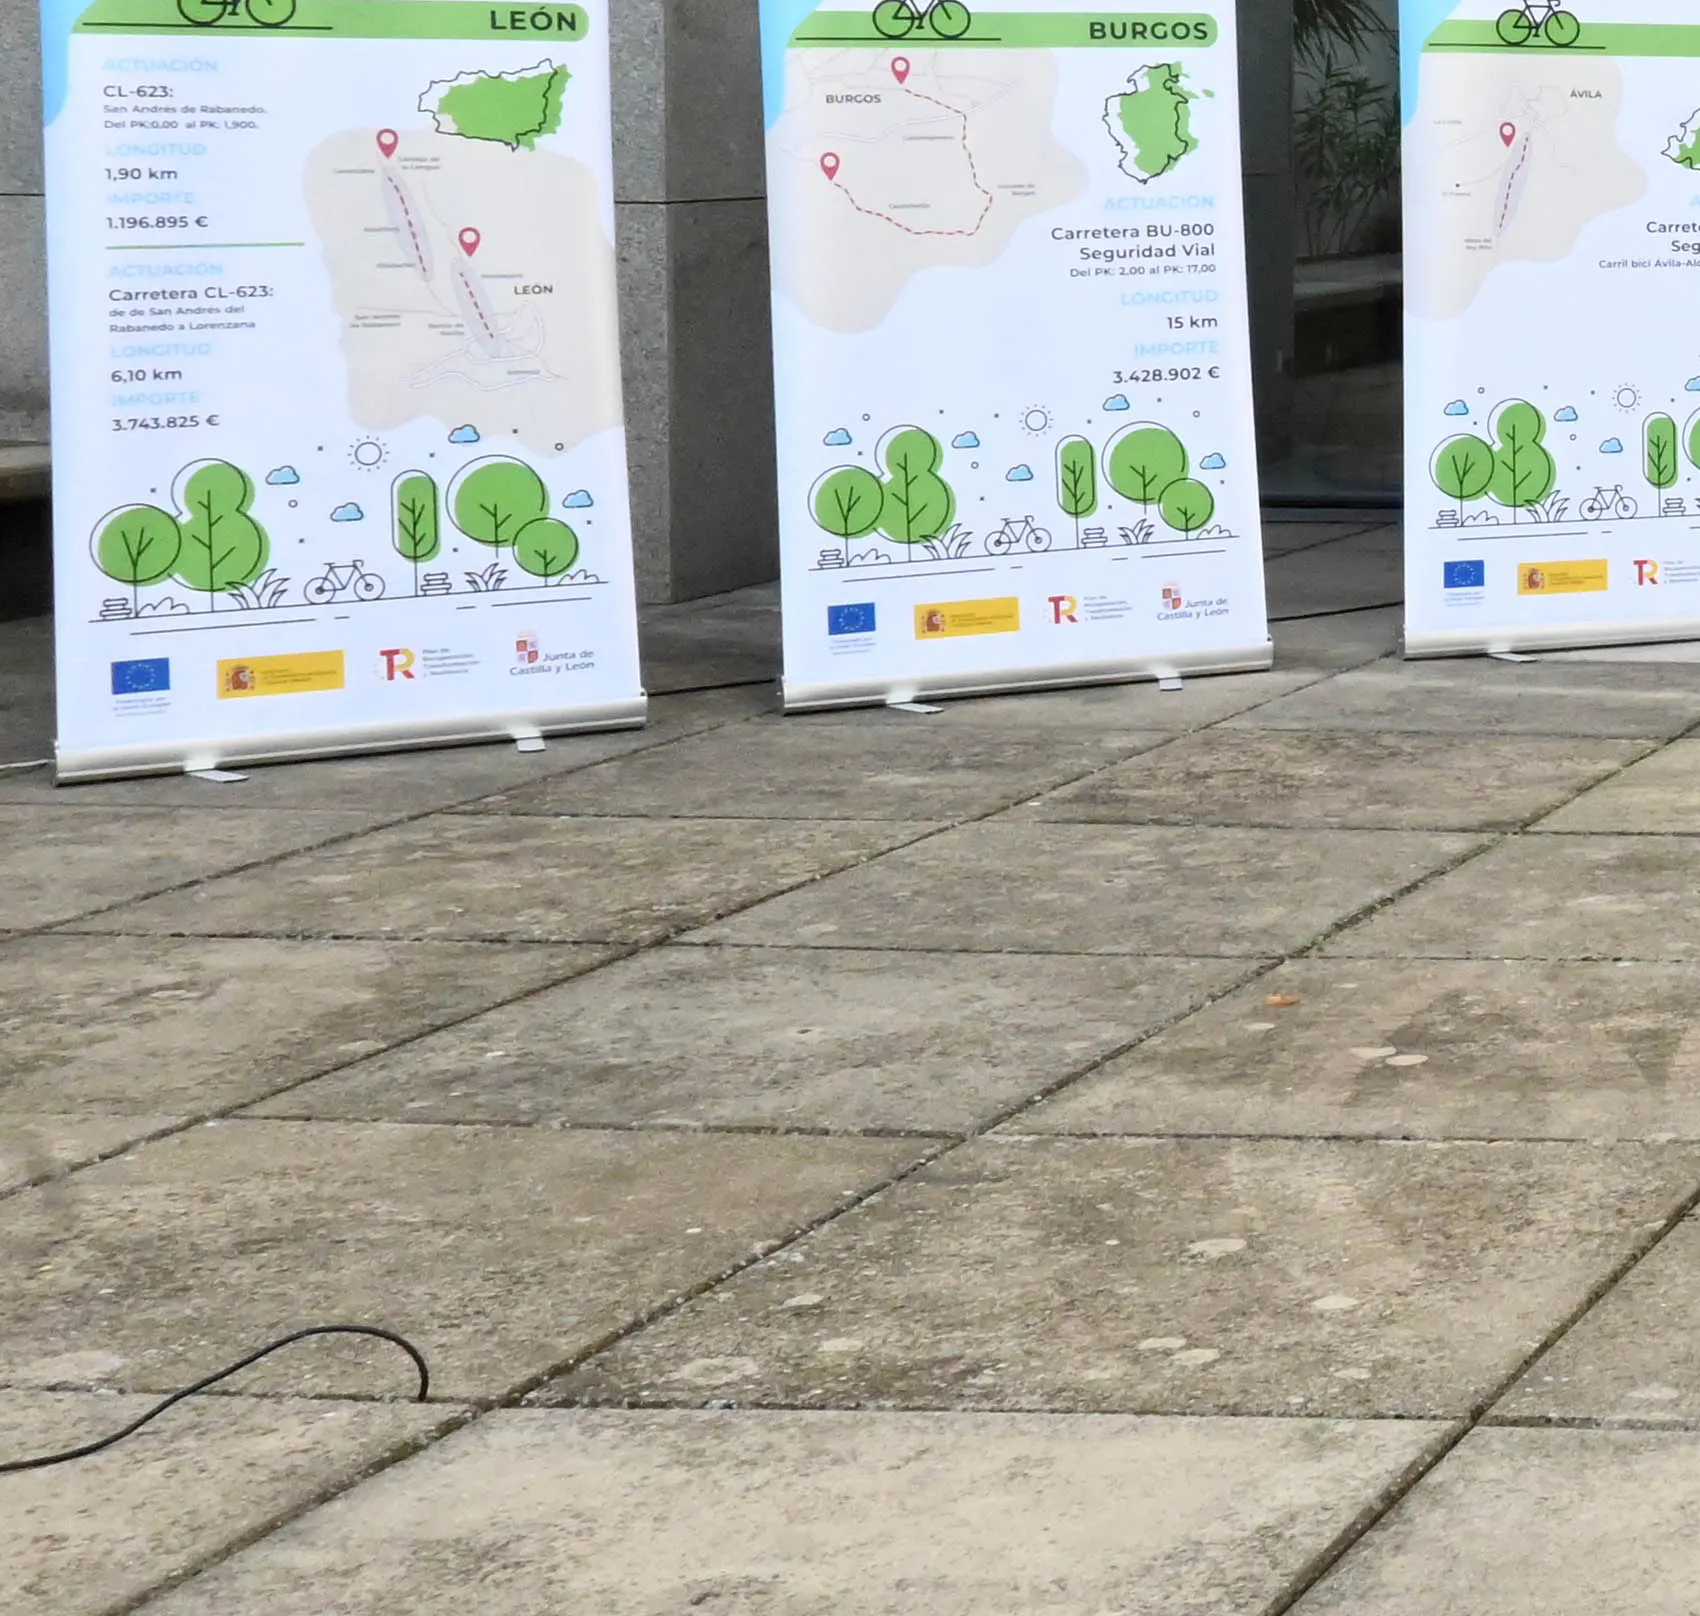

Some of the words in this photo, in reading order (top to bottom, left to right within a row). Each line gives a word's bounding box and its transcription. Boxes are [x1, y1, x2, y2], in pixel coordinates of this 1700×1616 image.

[489, 4, 577, 32] LEÓN
[1089, 21, 1208, 41] BURGOS
[103, 85, 174, 99] CL-623:
[825, 93, 882, 104] BURGOS
[1569, 89, 1603, 99] ÁVILA
[105, 167, 142, 182] 1,90
[148, 167, 178, 180] km
[106, 215, 189, 229] 1.196.895
[194, 215, 209, 228] €
[1050, 227, 1140, 241] Carretera
[1146, 222, 1215, 238] BU-800
[1079, 244, 1177, 263] Seguridad
[1181, 242, 1215, 257] Vial
[108, 288, 198, 302] Carretera
[204, 285, 274, 299] CL-623:
[1167, 316, 1184, 330] 15
[1189, 315, 1218, 329] km
[110, 368, 147, 384] 6,10
[152, 368, 183, 381] km
[1113, 366, 1201, 384] 3.428.902
[1207, 365, 1220, 379] €
[112, 415, 200, 432] 3.743.825
[205, 414, 220, 427] €
